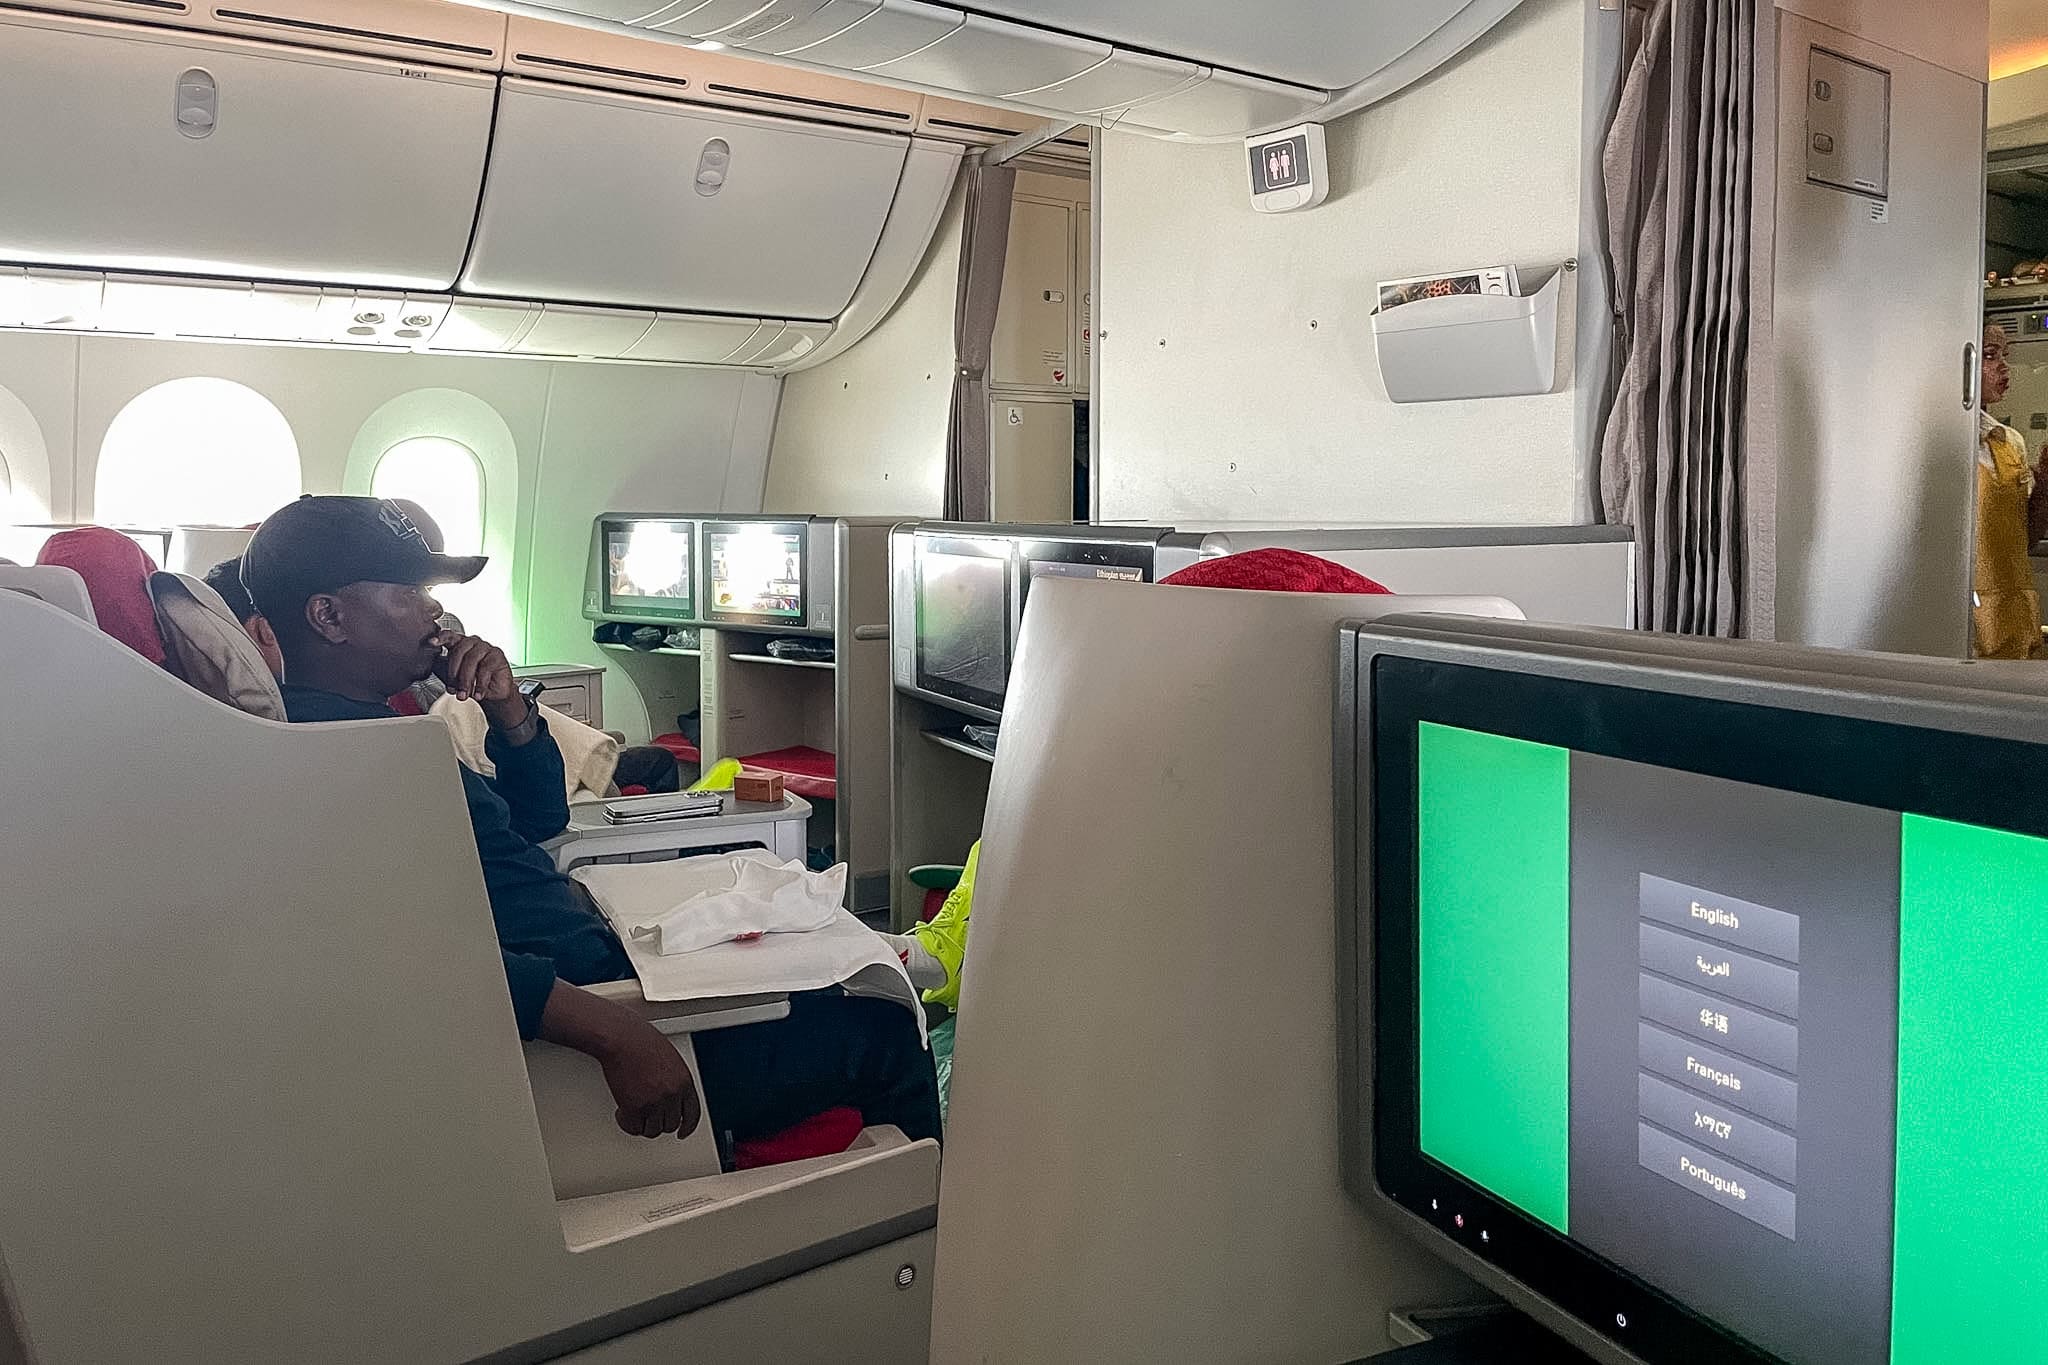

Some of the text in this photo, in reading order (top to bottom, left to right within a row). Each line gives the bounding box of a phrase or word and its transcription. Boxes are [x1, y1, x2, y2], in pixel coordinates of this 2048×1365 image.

[1691, 902, 1739, 929] English
[1696, 955, 1730, 977] العربية
[1699, 1008, 1729, 1034] 华语
[1686, 1056, 1741, 1091] Français
[1694, 1111, 1732, 1139] አማርኛ
[1680, 1157, 1746, 1200] Português
